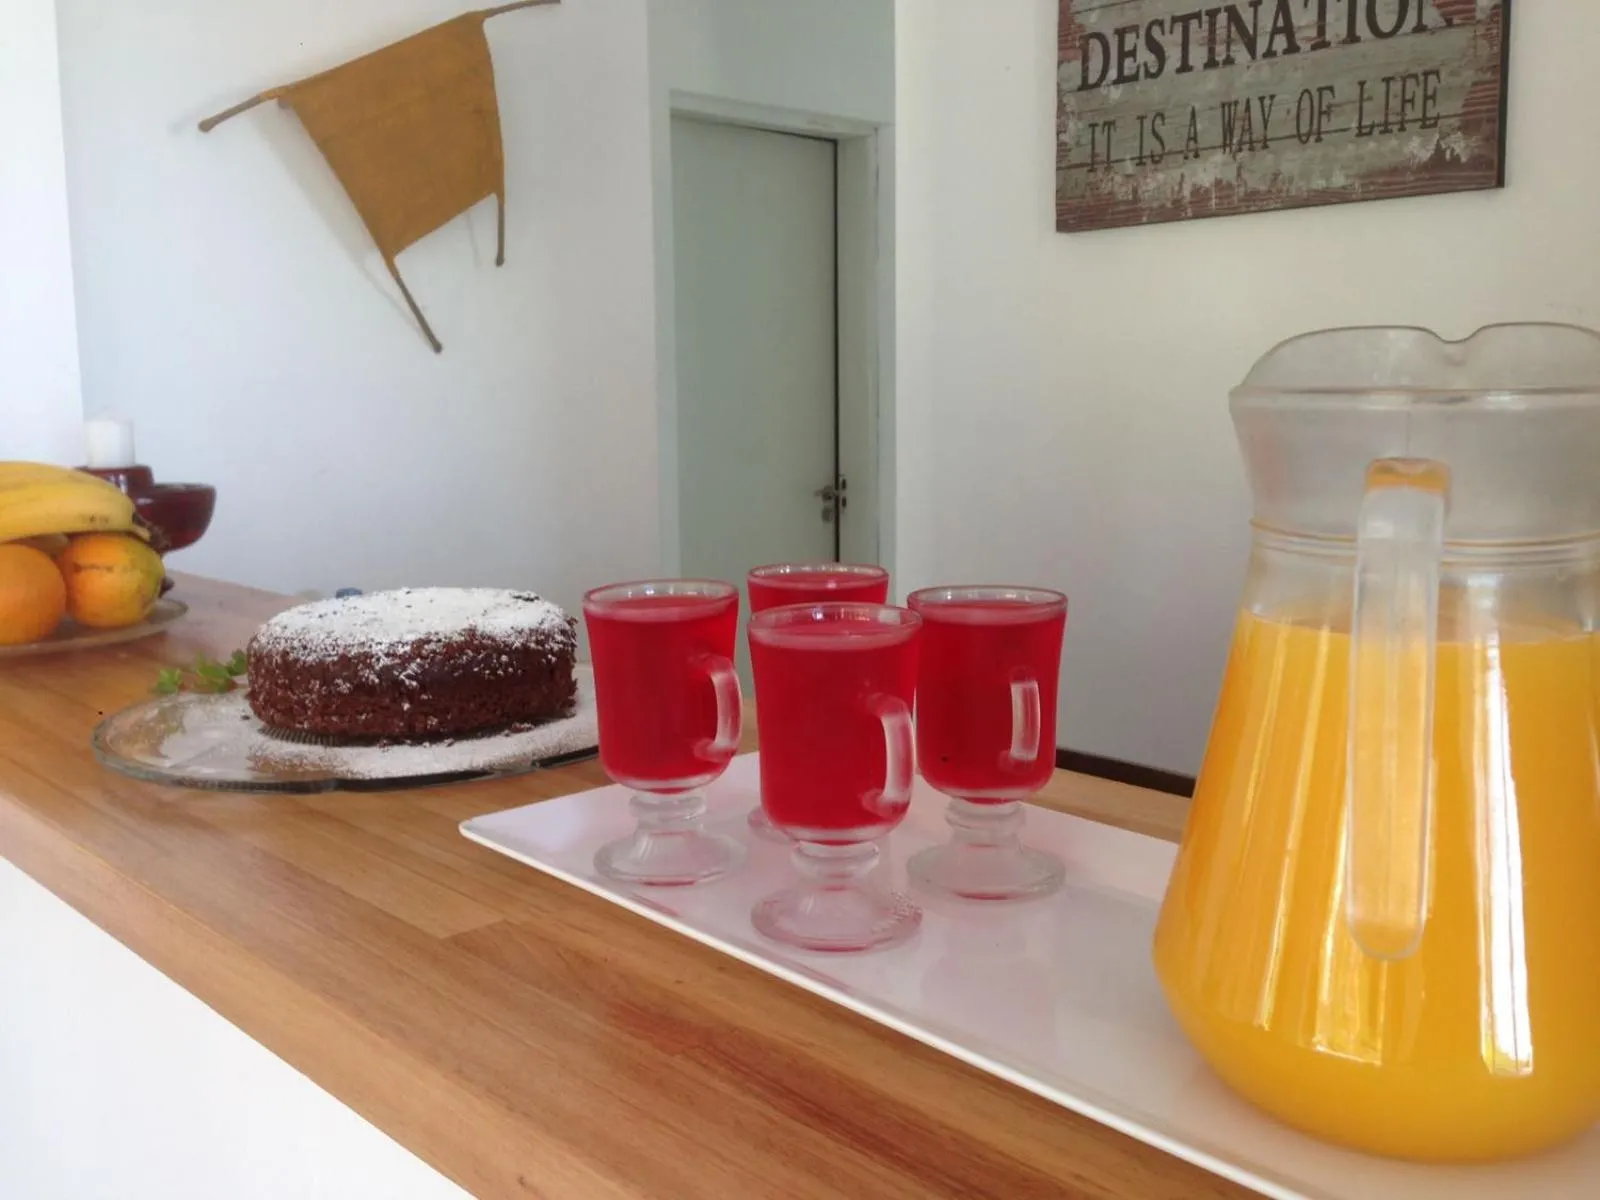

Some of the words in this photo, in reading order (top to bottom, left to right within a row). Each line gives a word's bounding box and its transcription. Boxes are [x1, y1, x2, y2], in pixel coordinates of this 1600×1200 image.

[1087, 120, 1117, 172] IT
[1136, 112, 1166, 166] IS
[1184, 105, 1200, 160] A
[1221, 94, 1276, 158] WAY
[1296, 85, 1336, 145] OF
[1356, 70, 1441, 137] LIFE
